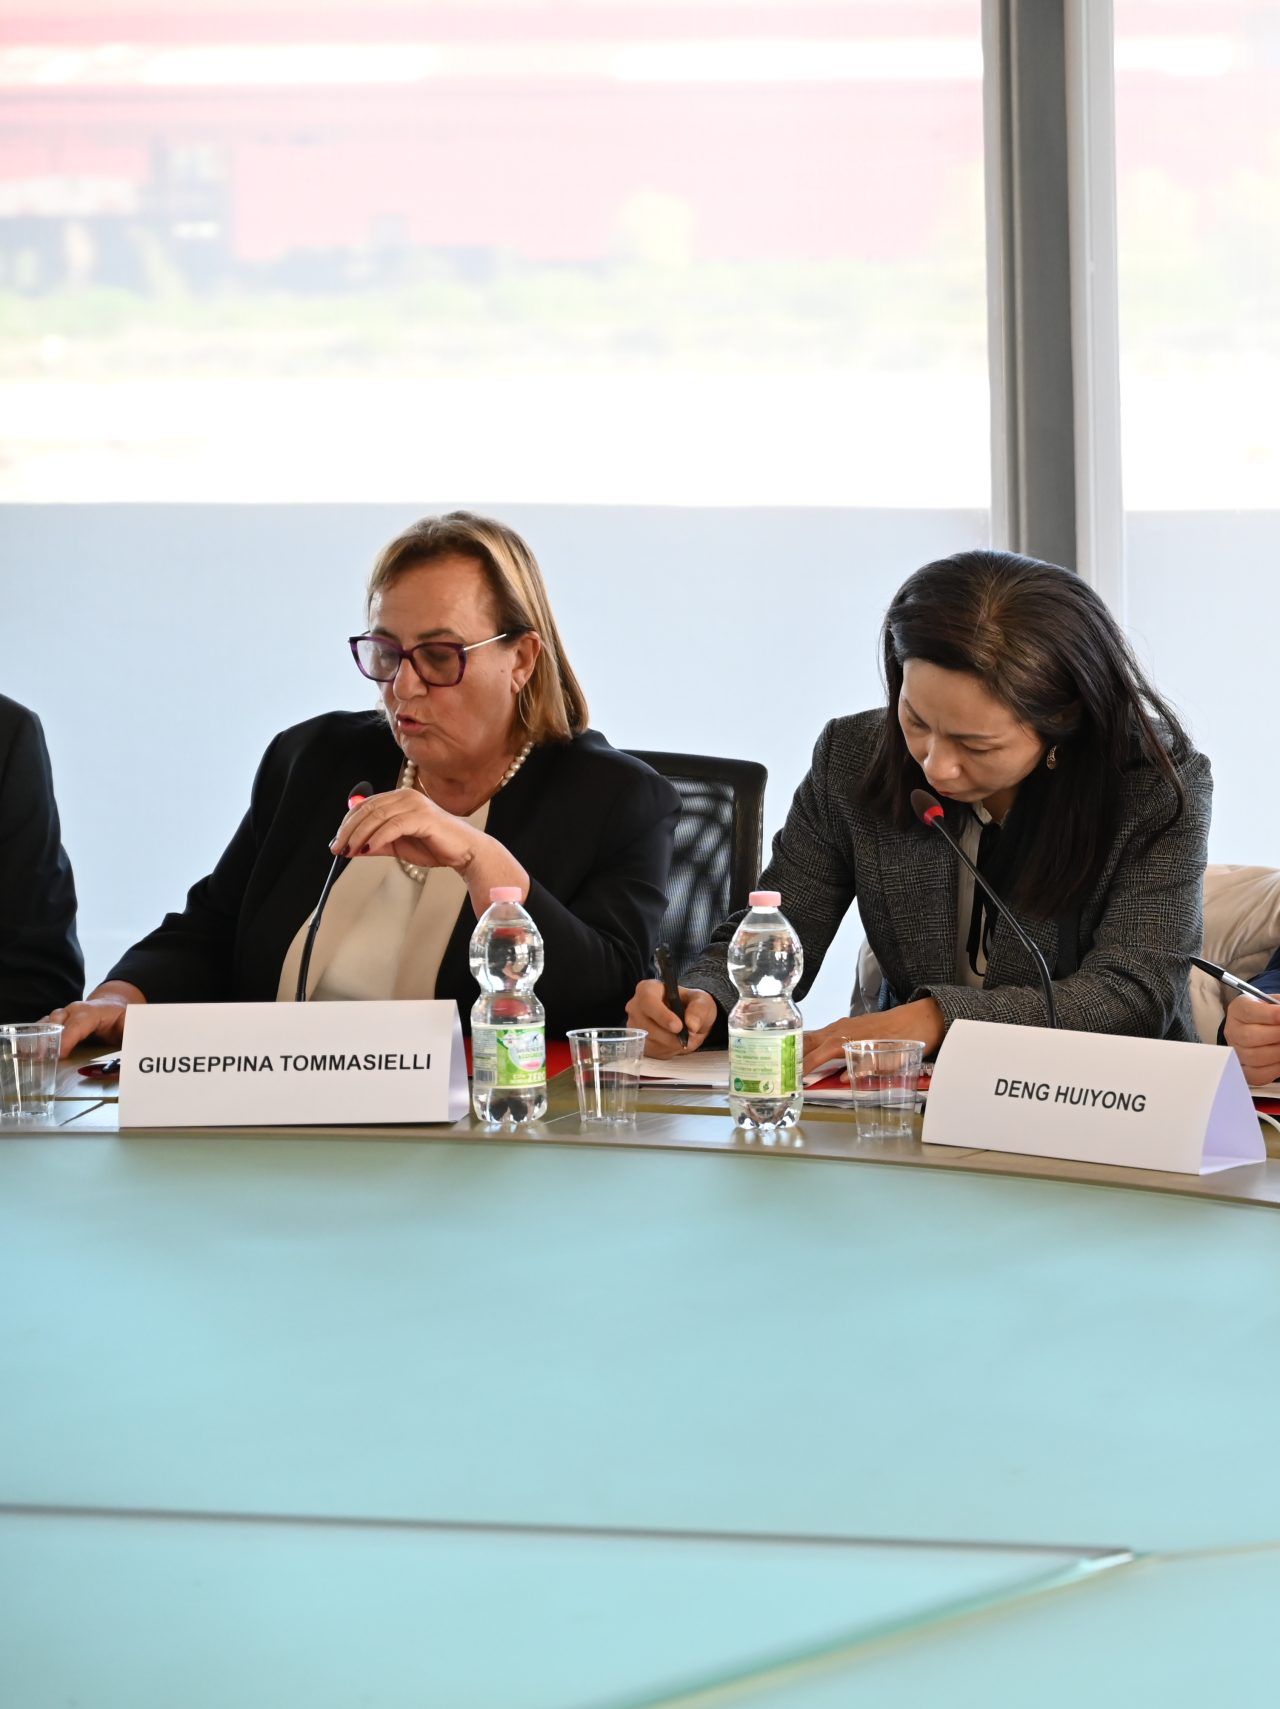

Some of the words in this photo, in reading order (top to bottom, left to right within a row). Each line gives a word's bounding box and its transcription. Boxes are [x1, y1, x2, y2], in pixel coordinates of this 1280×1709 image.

[138, 1055, 274, 1074] GIUSEPPINA
[279, 1053, 431, 1072] TOMMASIELLI
[994, 1078, 1050, 1102] DENG
[1054, 1085, 1147, 1113] HUIYONG
